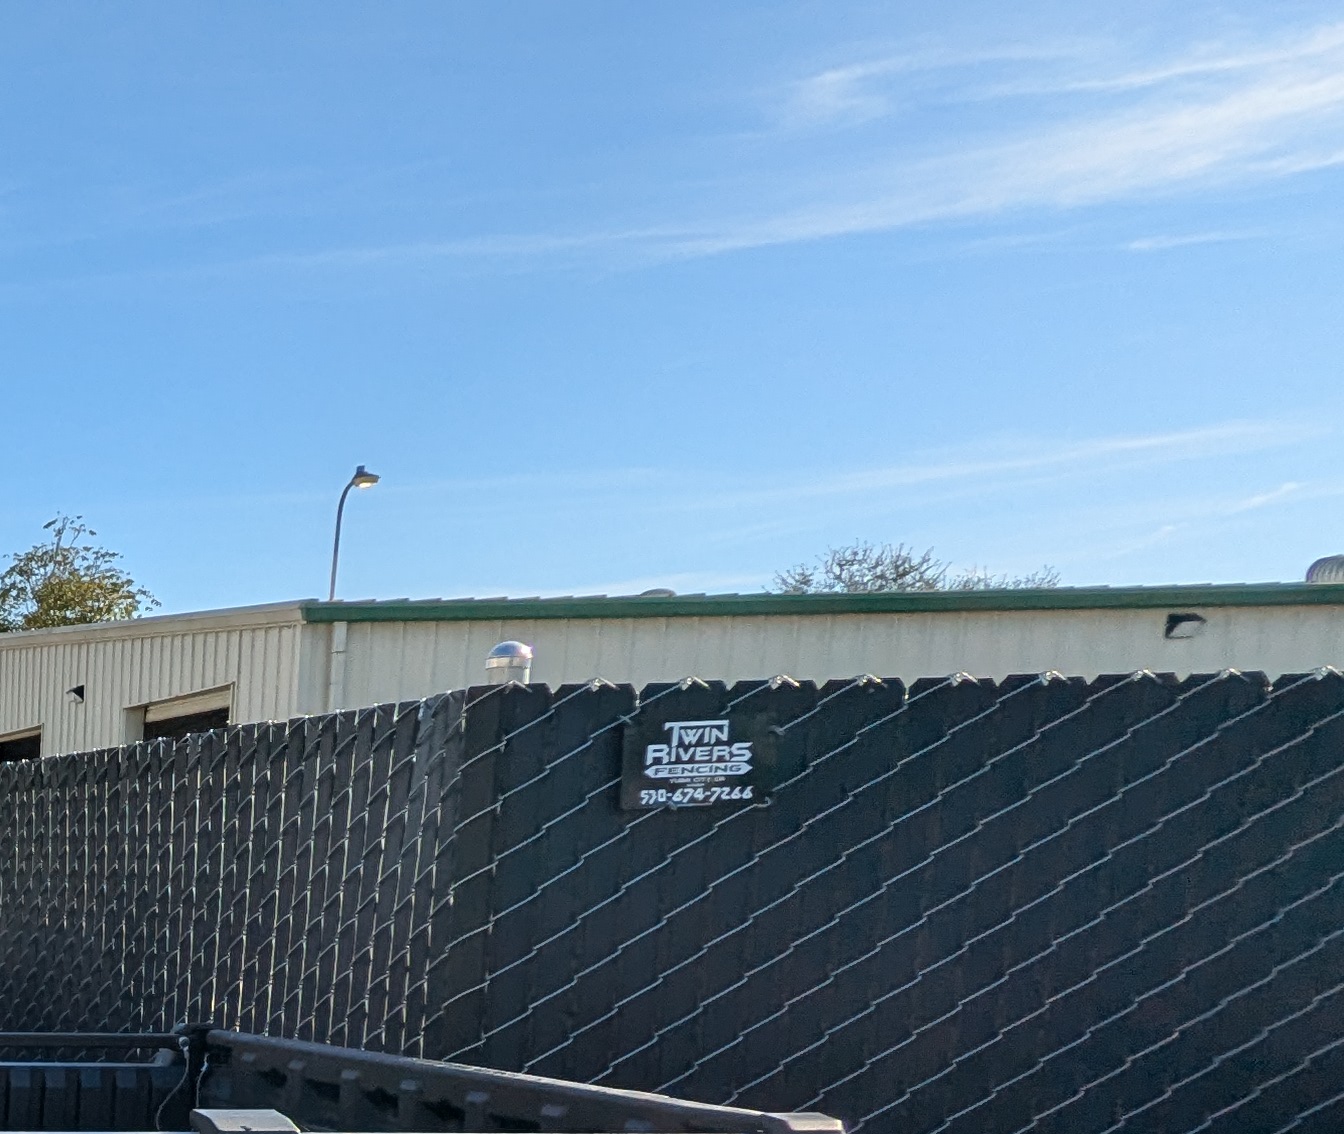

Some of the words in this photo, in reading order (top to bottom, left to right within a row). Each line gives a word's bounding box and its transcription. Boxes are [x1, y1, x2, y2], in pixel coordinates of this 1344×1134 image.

[664, 719, 730, 747] TWIN
[645, 741, 753, 766] RIVERS
[653, 763, 743, 776] FENCING
[640, 785, 754, 805] 530-674-7266
